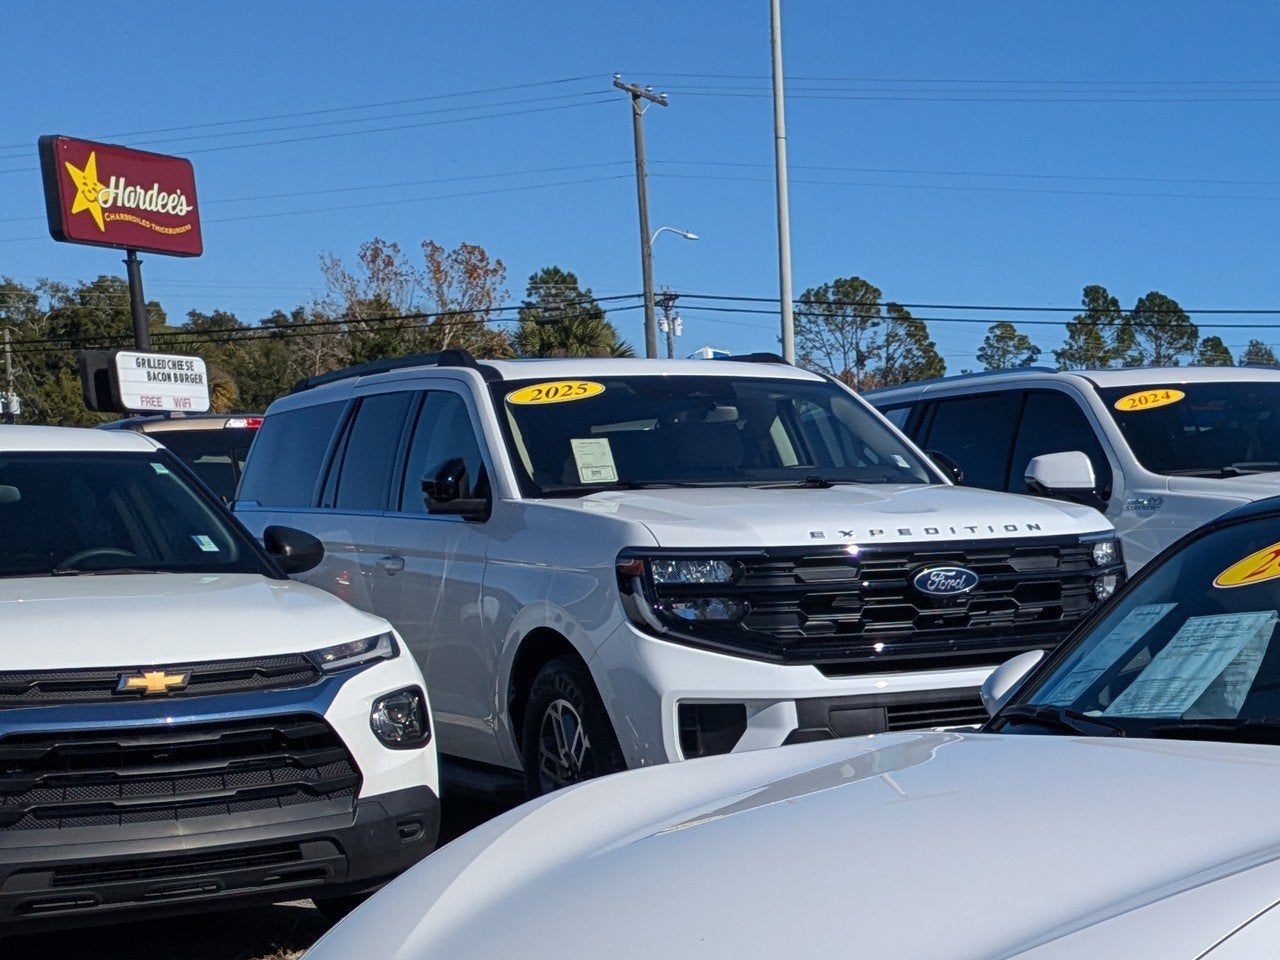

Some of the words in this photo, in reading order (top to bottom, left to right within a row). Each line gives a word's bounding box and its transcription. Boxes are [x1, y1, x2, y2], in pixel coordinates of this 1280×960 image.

[98, 176, 193, 216] Hardee's
[104, 212, 151, 228] CHARBROILED
[135, 357, 167, 370] GRILLED
[167, 359, 195, 371] CHEESE
[147, 371, 172, 383] BACON
[173, 372, 204, 384] BURGER
[529, 382, 589, 402] 2025
[1127, 391, 1171, 409] 2024
[140, 396, 163, 407] FREE
[809, 522, 1042, 539] EXPEDITION
[926, 570, 966, 592] Ford
